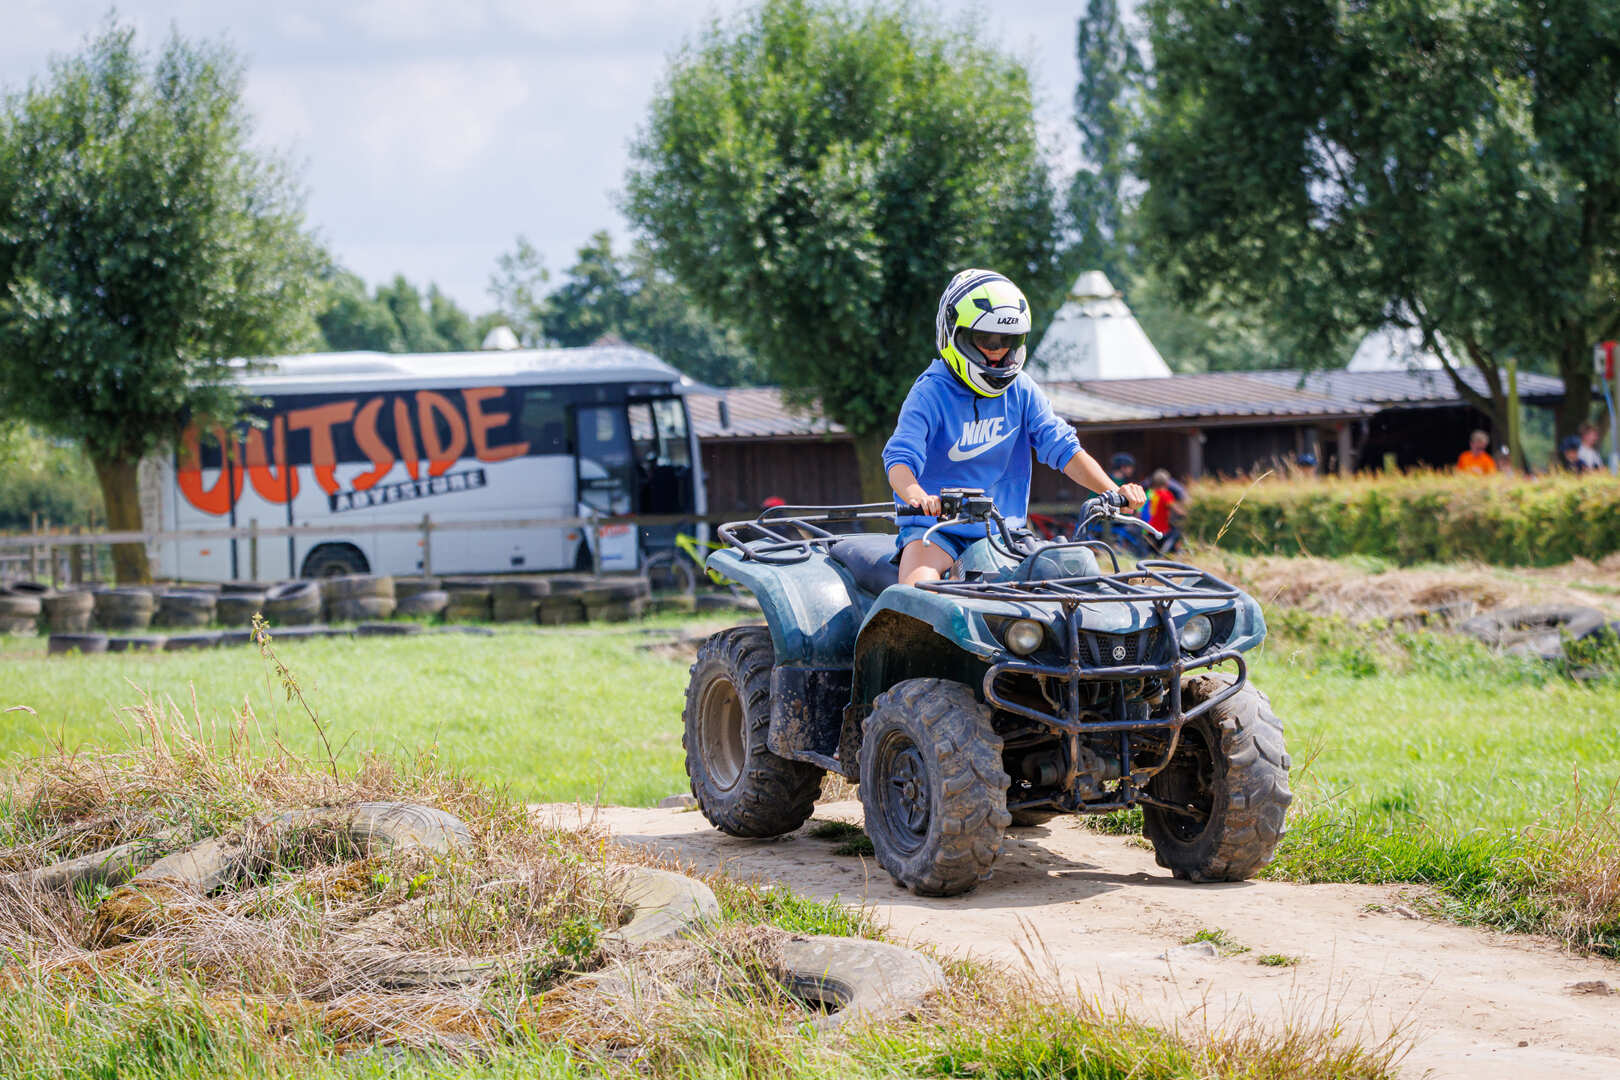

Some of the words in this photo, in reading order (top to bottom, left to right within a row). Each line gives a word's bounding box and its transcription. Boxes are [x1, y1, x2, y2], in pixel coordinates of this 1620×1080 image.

[997, 316, 1019, 325] LAZER
[960, 416, 1005, 447] NIKE
[177, 386, 531, 516] OUTSIDE
[335, 470, 482, 512] ADVENTURE
